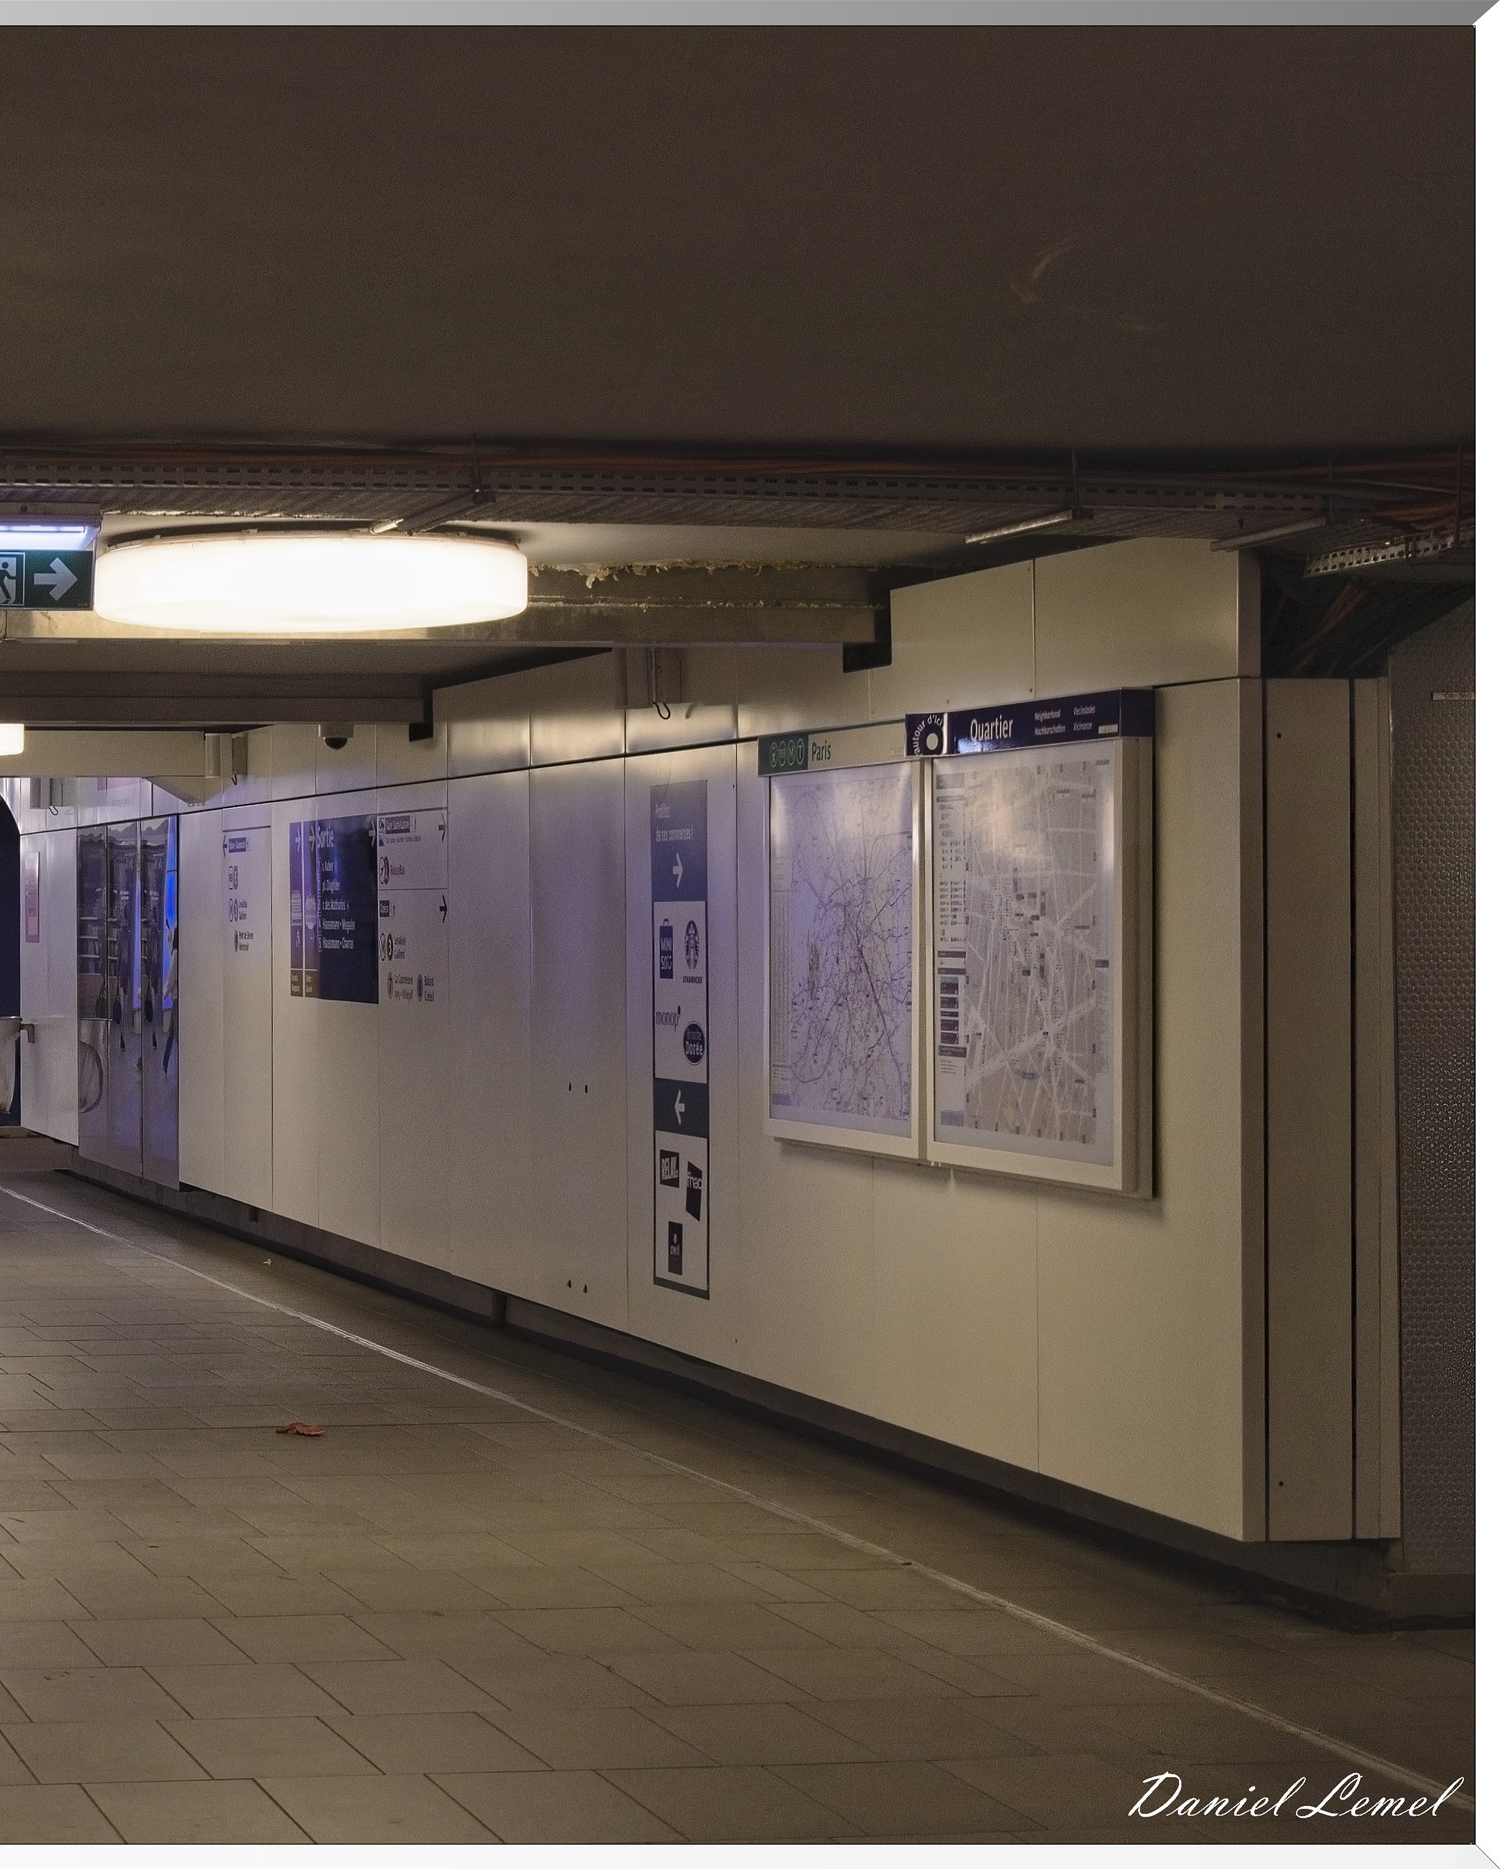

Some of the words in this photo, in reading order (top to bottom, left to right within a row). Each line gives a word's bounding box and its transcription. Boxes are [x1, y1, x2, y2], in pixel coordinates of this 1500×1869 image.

[970, 714, 1014, 742] Quartier
[811, 740, 832, 762] Paris
[317, 825, 335, 849] Sortie
[682, 975, 703, 984] STARBUCKS
[685, 1041, 703, 1056] Dorée
[687, 1171, 703, 1190] fnac
